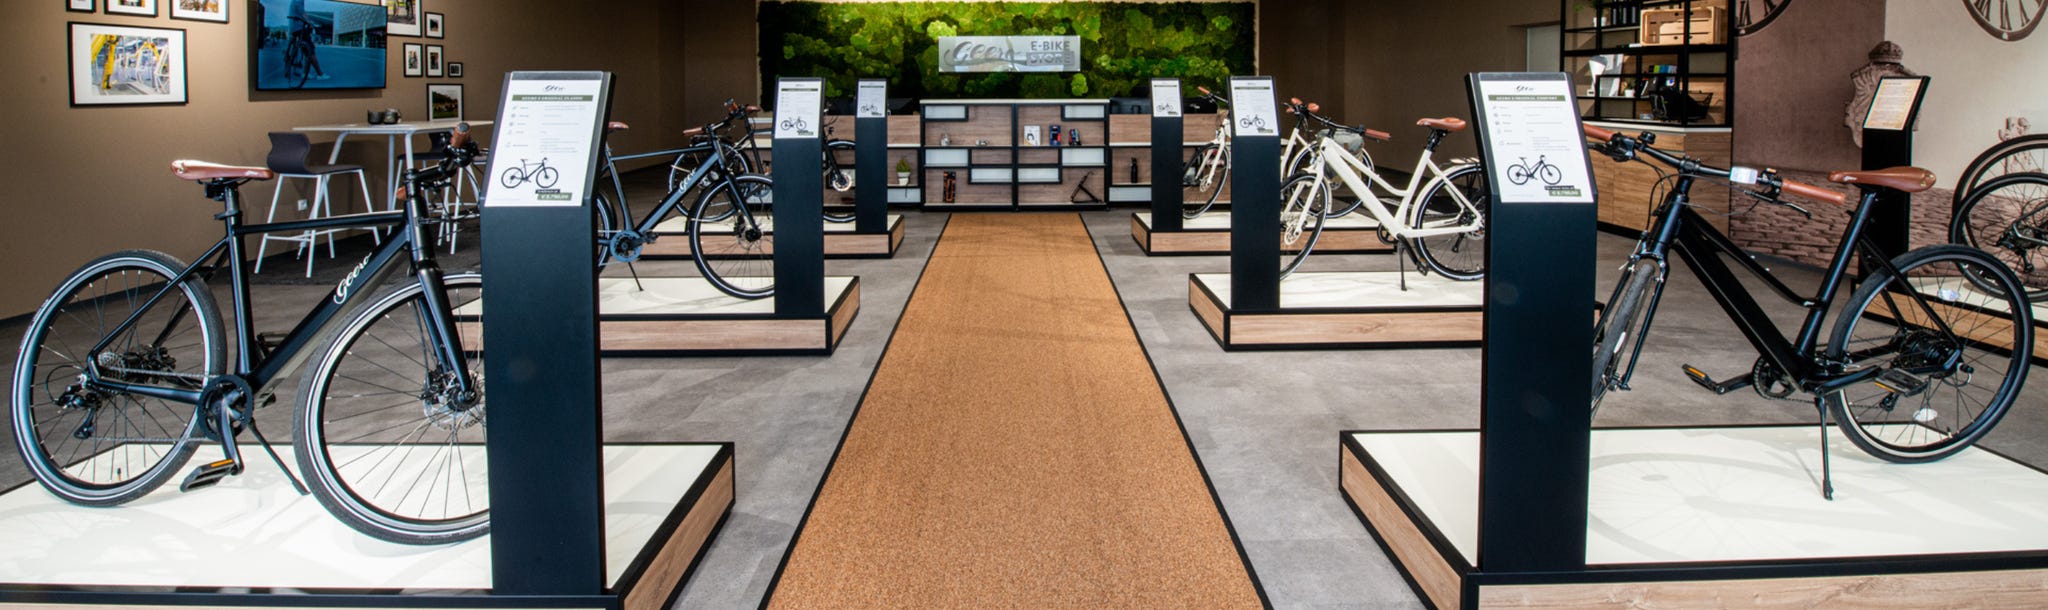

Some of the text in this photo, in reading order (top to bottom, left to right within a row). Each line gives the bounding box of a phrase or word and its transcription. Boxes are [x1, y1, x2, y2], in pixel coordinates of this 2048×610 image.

[1030, 41, 1070, 51] E-BIKE
[1030, 53, 1071, 64] STORE
[333, 252, 372, 304] Geero
